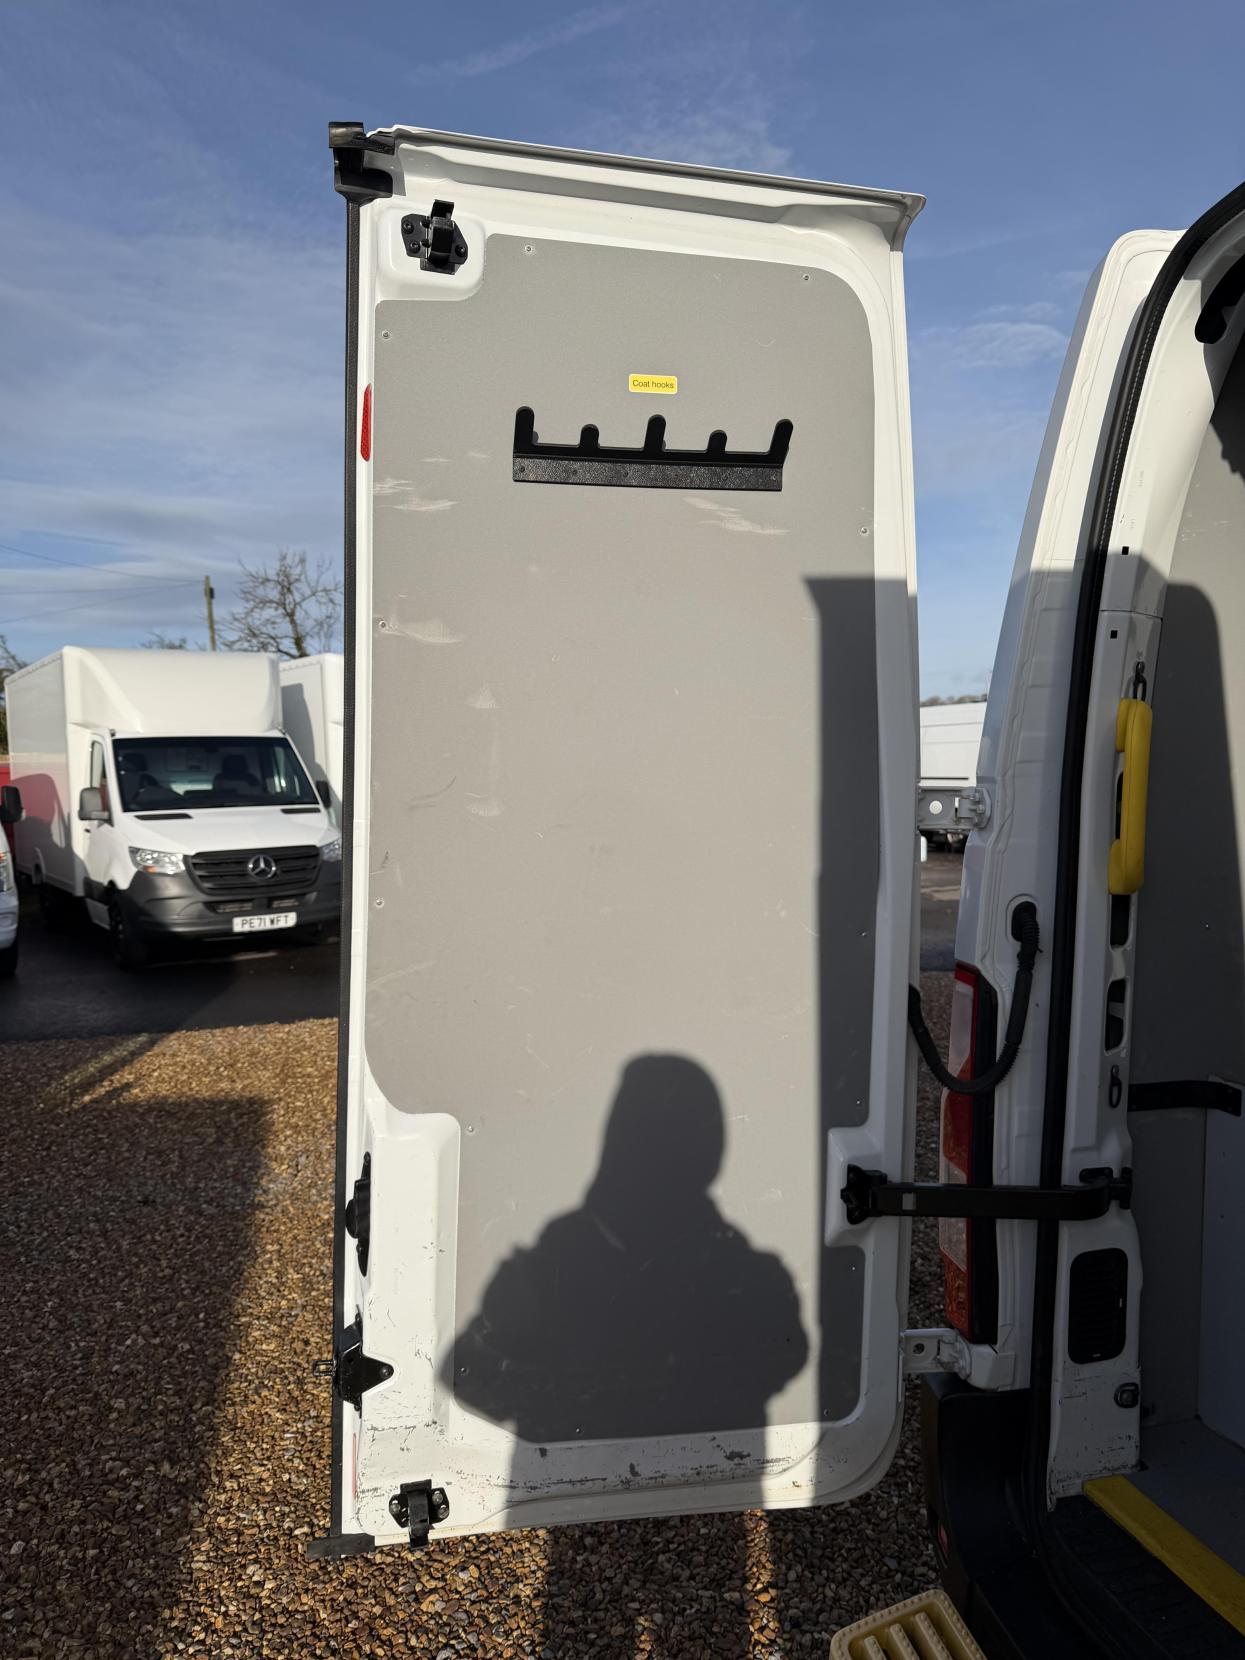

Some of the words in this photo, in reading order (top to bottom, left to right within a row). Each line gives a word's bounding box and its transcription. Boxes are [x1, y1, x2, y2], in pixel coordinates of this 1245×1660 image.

[632, 379, 650, 388] Coat
[651, 381, 675, 389] hooks
[241, 917, 267, 929] PE71
[269, 914, 289, 926] WFT
